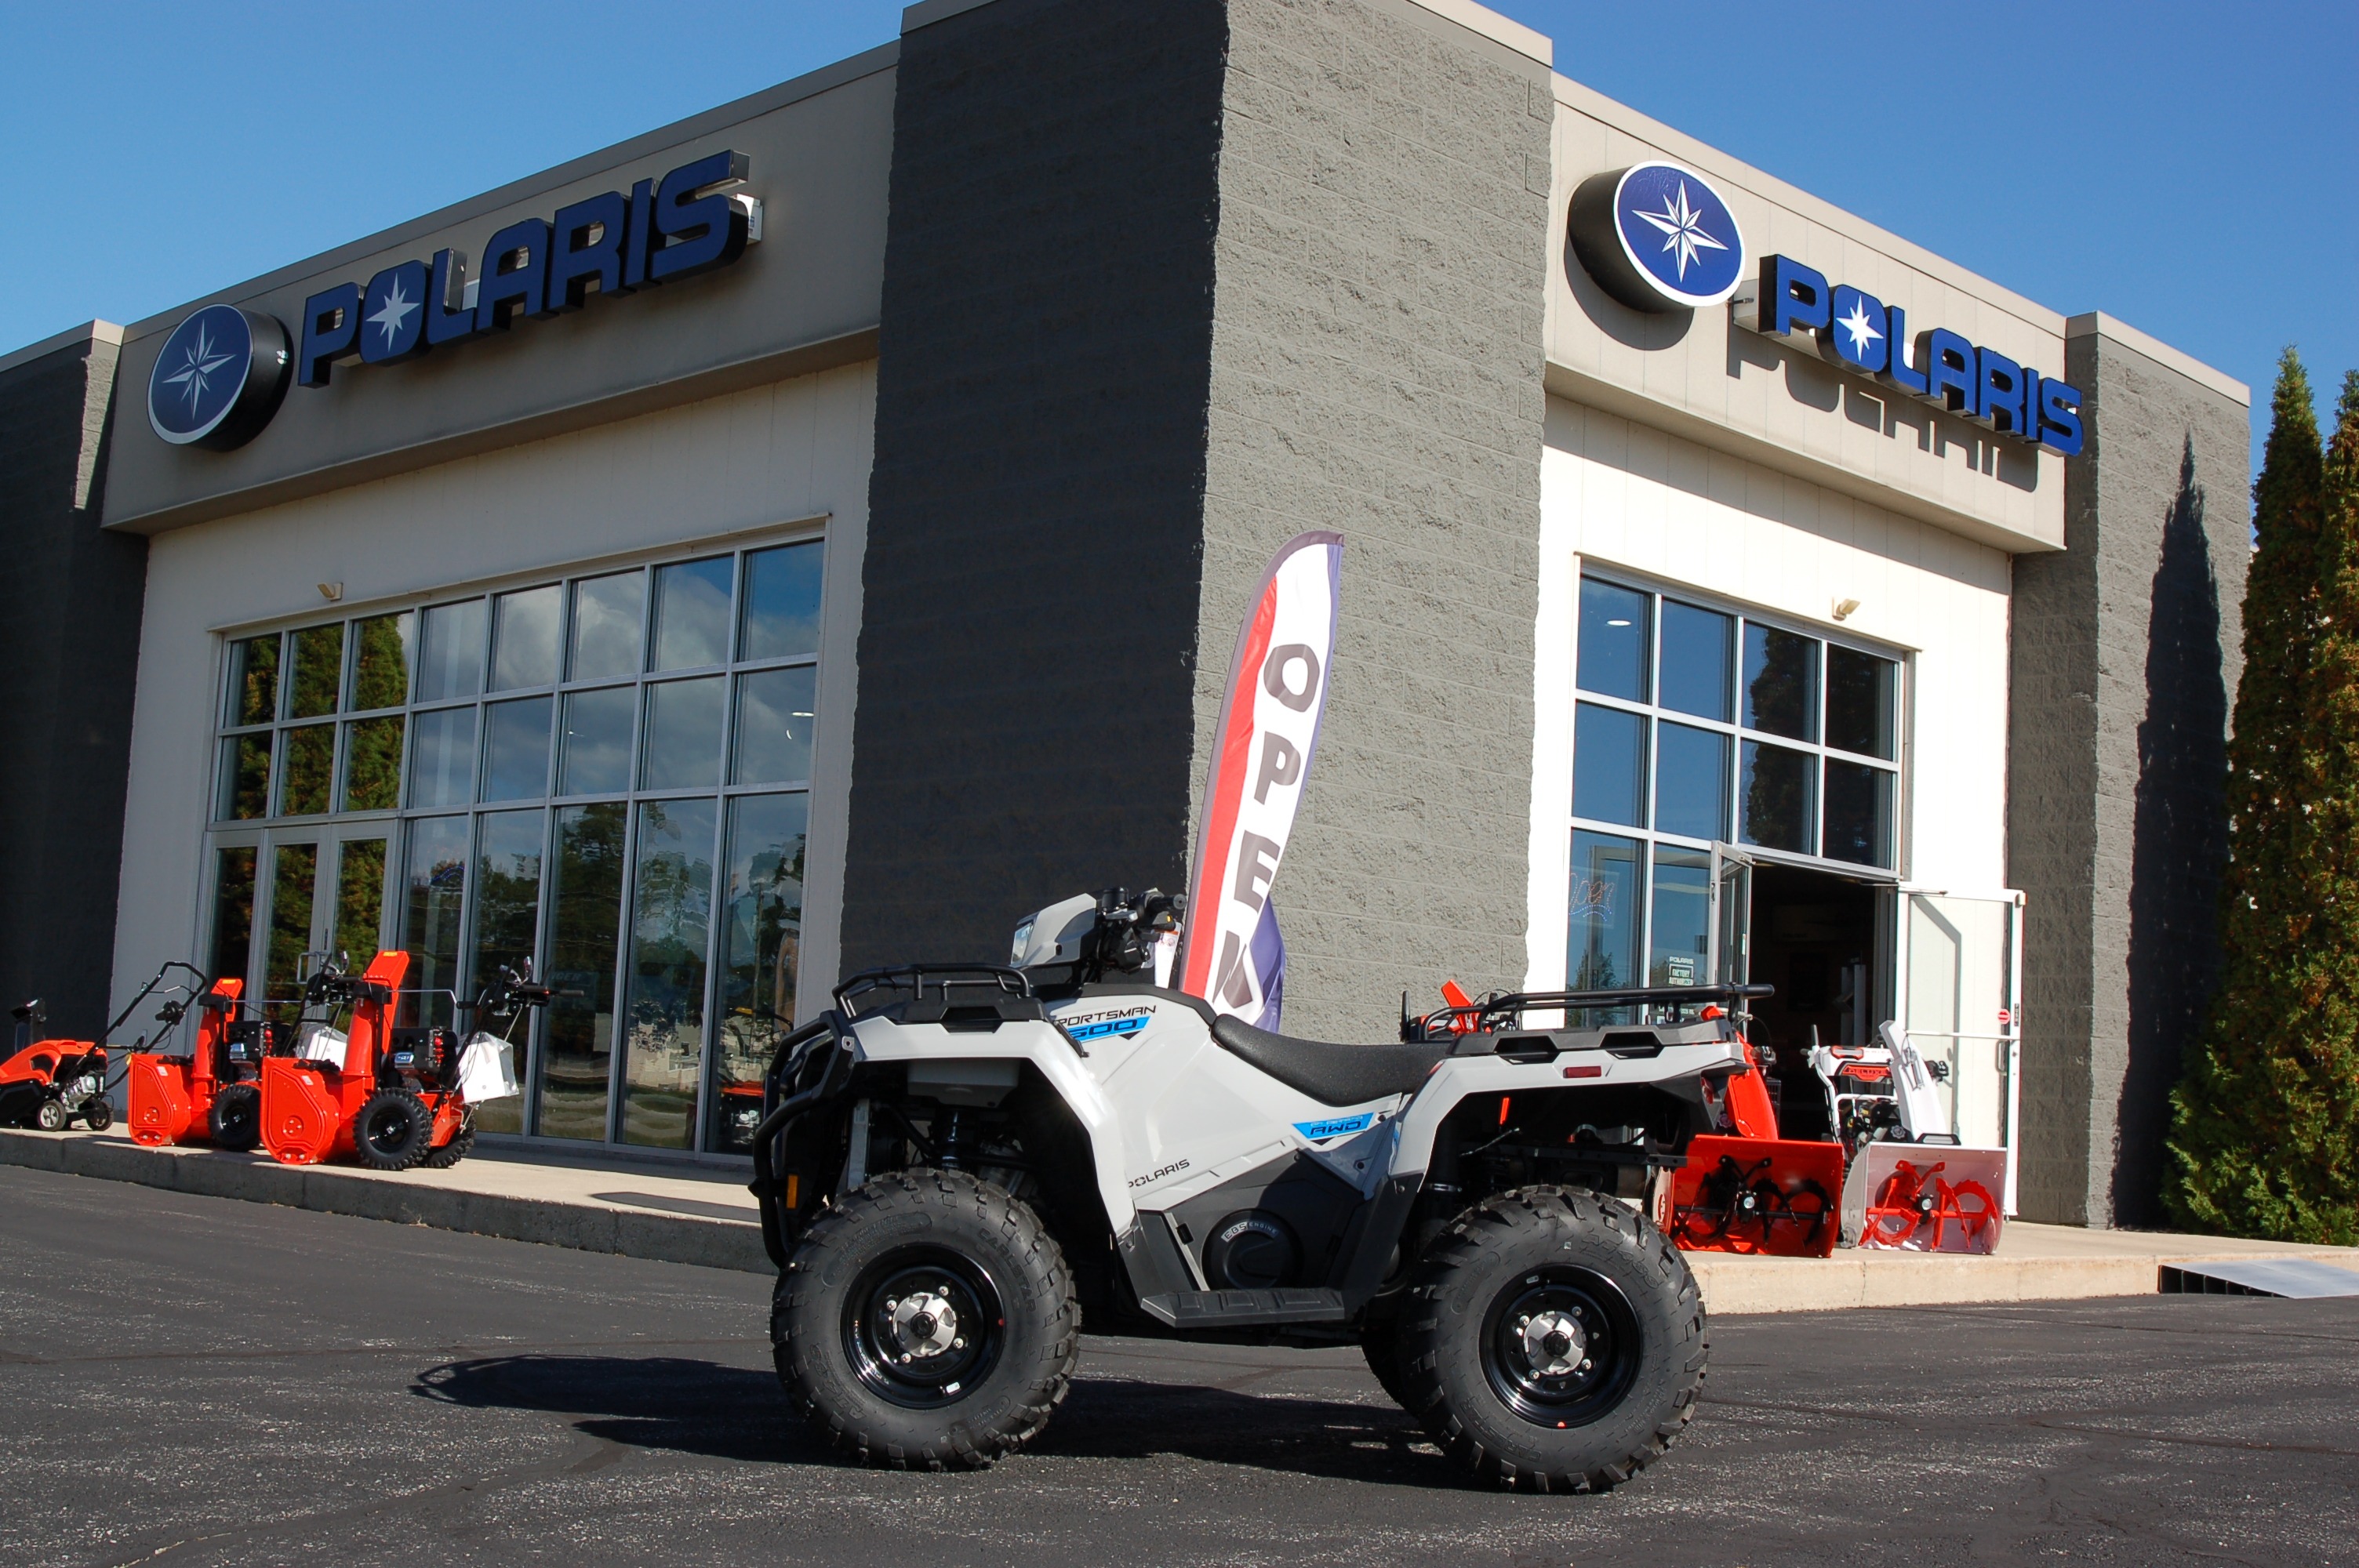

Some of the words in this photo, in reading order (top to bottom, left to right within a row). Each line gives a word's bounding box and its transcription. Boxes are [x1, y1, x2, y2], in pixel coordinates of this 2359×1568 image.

[298, 149, 749, 387] POLARIS
[1760, 254, 2084, 456] POLARIS
[1212, 643, 1321, 1009] OPEN
[1056, 1005, 1157, 1026] PORTSMAN
[1310, 1120, 1361, 1135] AWD
[978, 1228, 1036, 1312] CARLSTAR
[1223, 1222, 1248, 1240] EBS
[1249, 1221, 1278, 1235] ENGINE
